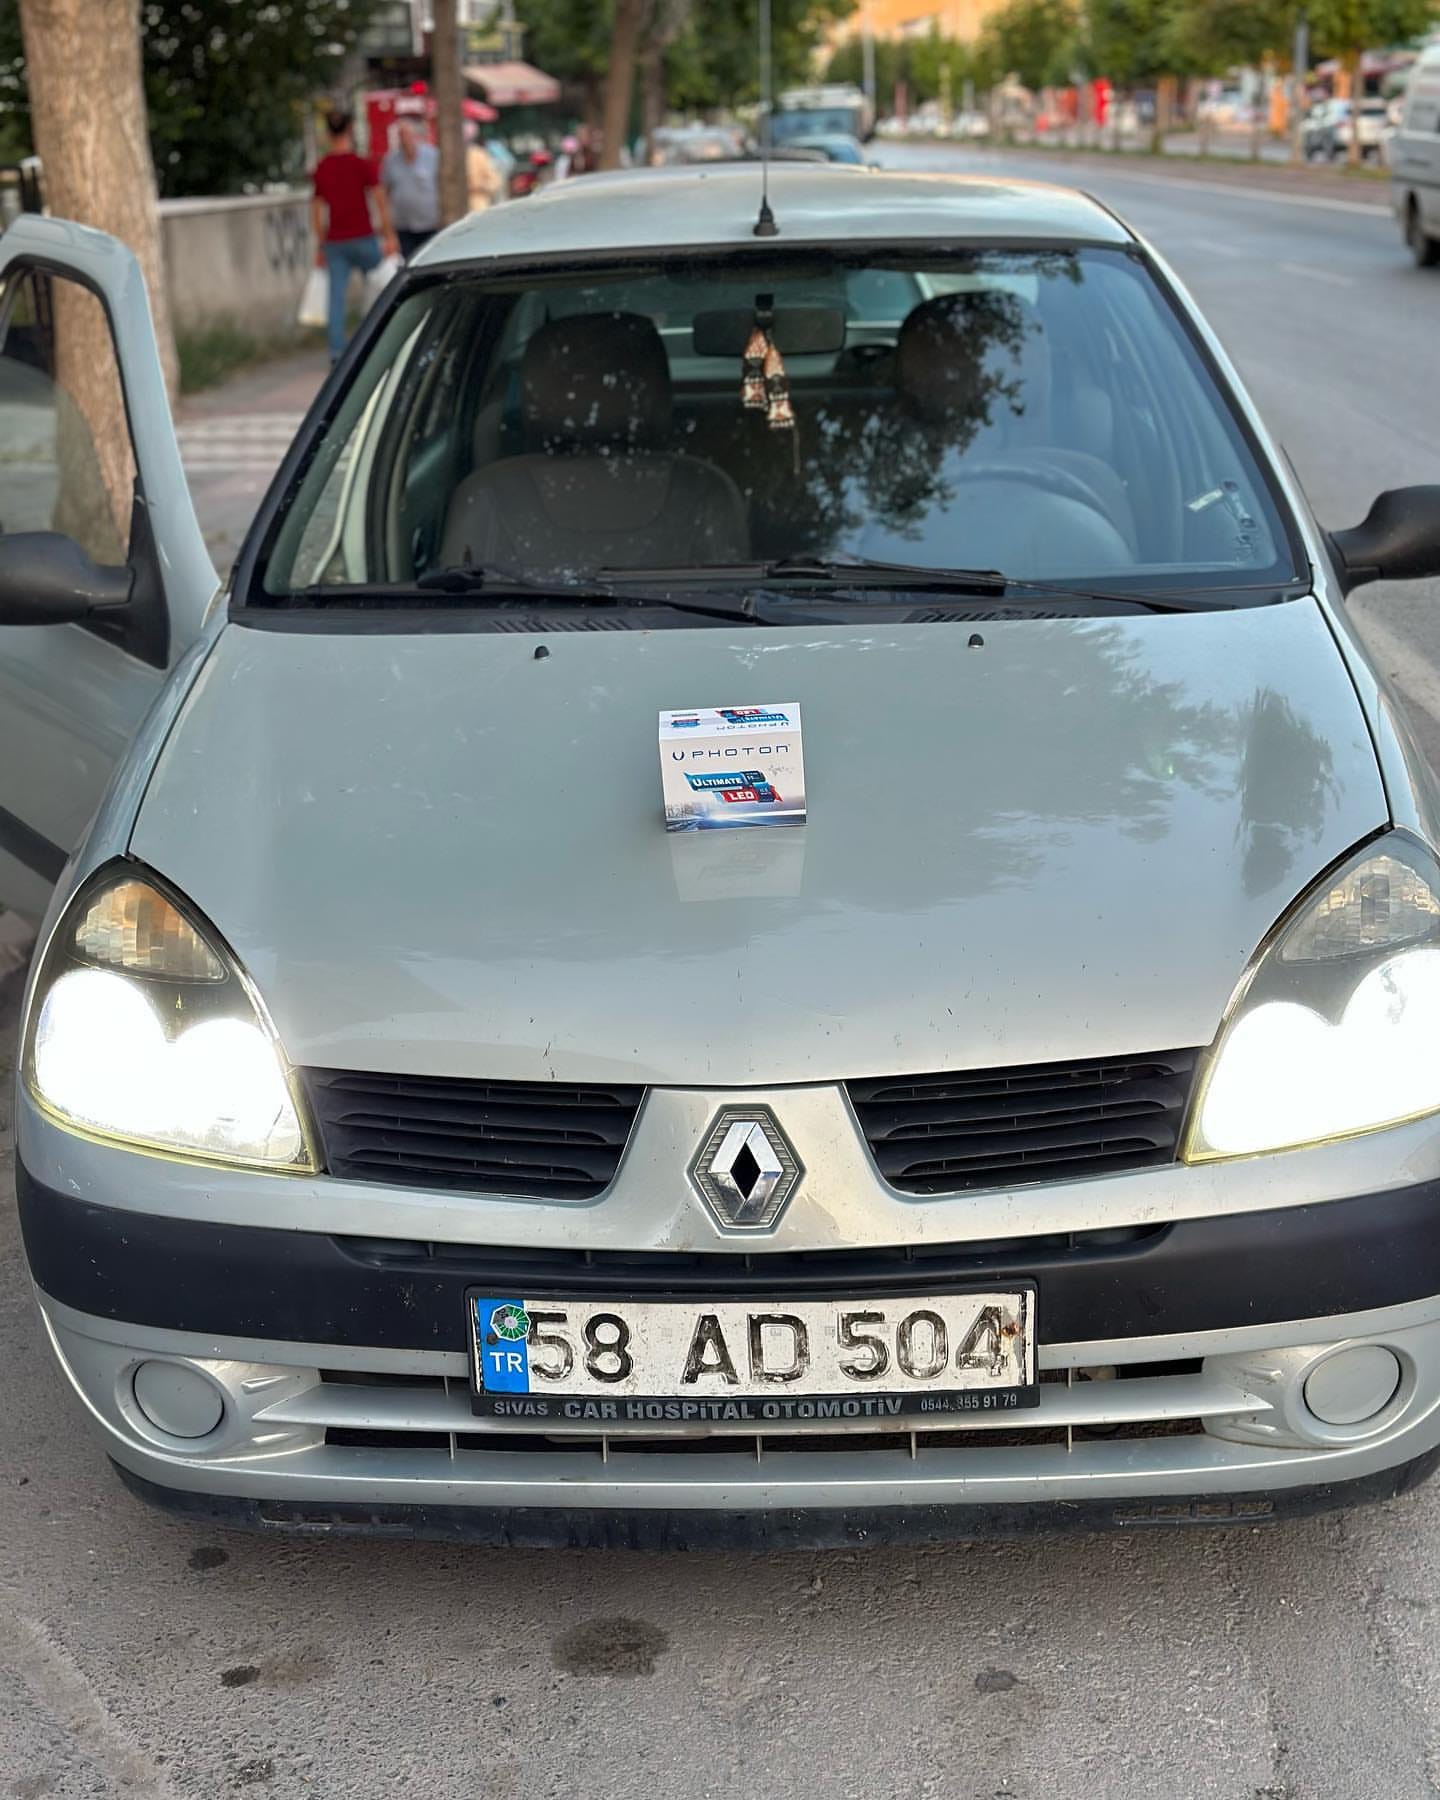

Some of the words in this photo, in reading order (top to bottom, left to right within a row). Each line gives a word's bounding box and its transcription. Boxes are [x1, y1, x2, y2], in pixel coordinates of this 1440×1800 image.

[692, 777, 744, 788] ULTIMATE
[729, 790, 755, 801] LED
[526, 1308, 635, 1385] 58
[680, 1312, 811, 1386] AD
[836, 1304, 1009, 1382] 504
[489, 1351, 524, 1374] TR
[564, 1400, 617, 1419] CAR
[983, 1394, 997, 1408] 91
[1003, 1393, 1017, 1407] 79
